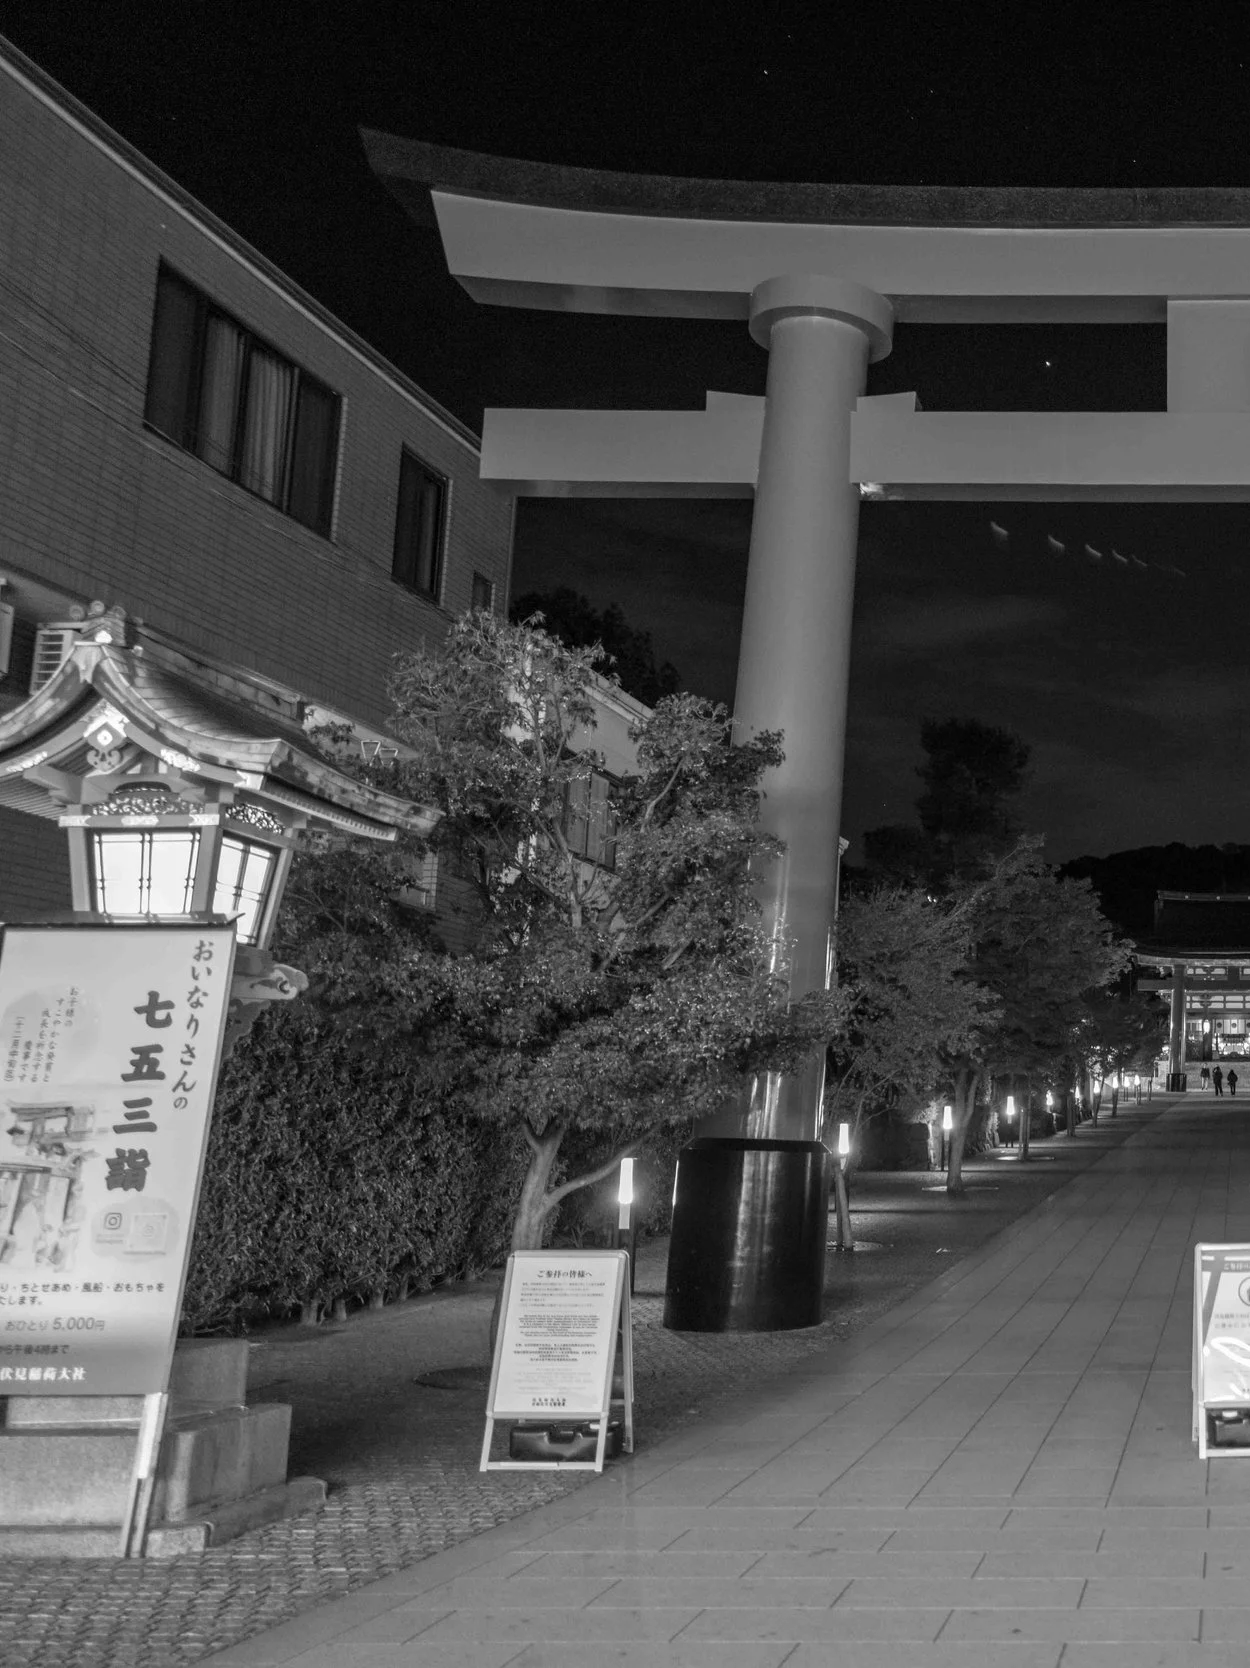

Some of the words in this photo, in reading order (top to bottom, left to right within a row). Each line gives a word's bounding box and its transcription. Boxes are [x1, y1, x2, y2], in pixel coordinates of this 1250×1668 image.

[172, 940, 214, 1109] おいなりさんの
[105, 990, 175, 1192] 七五三詣
[537, 1270, 592, 1279] ご参拝の皆様へ
[5, 1320, 49, 1331] おひとり
[0, 1367, 86, 1381] 伏見稲荷大社
